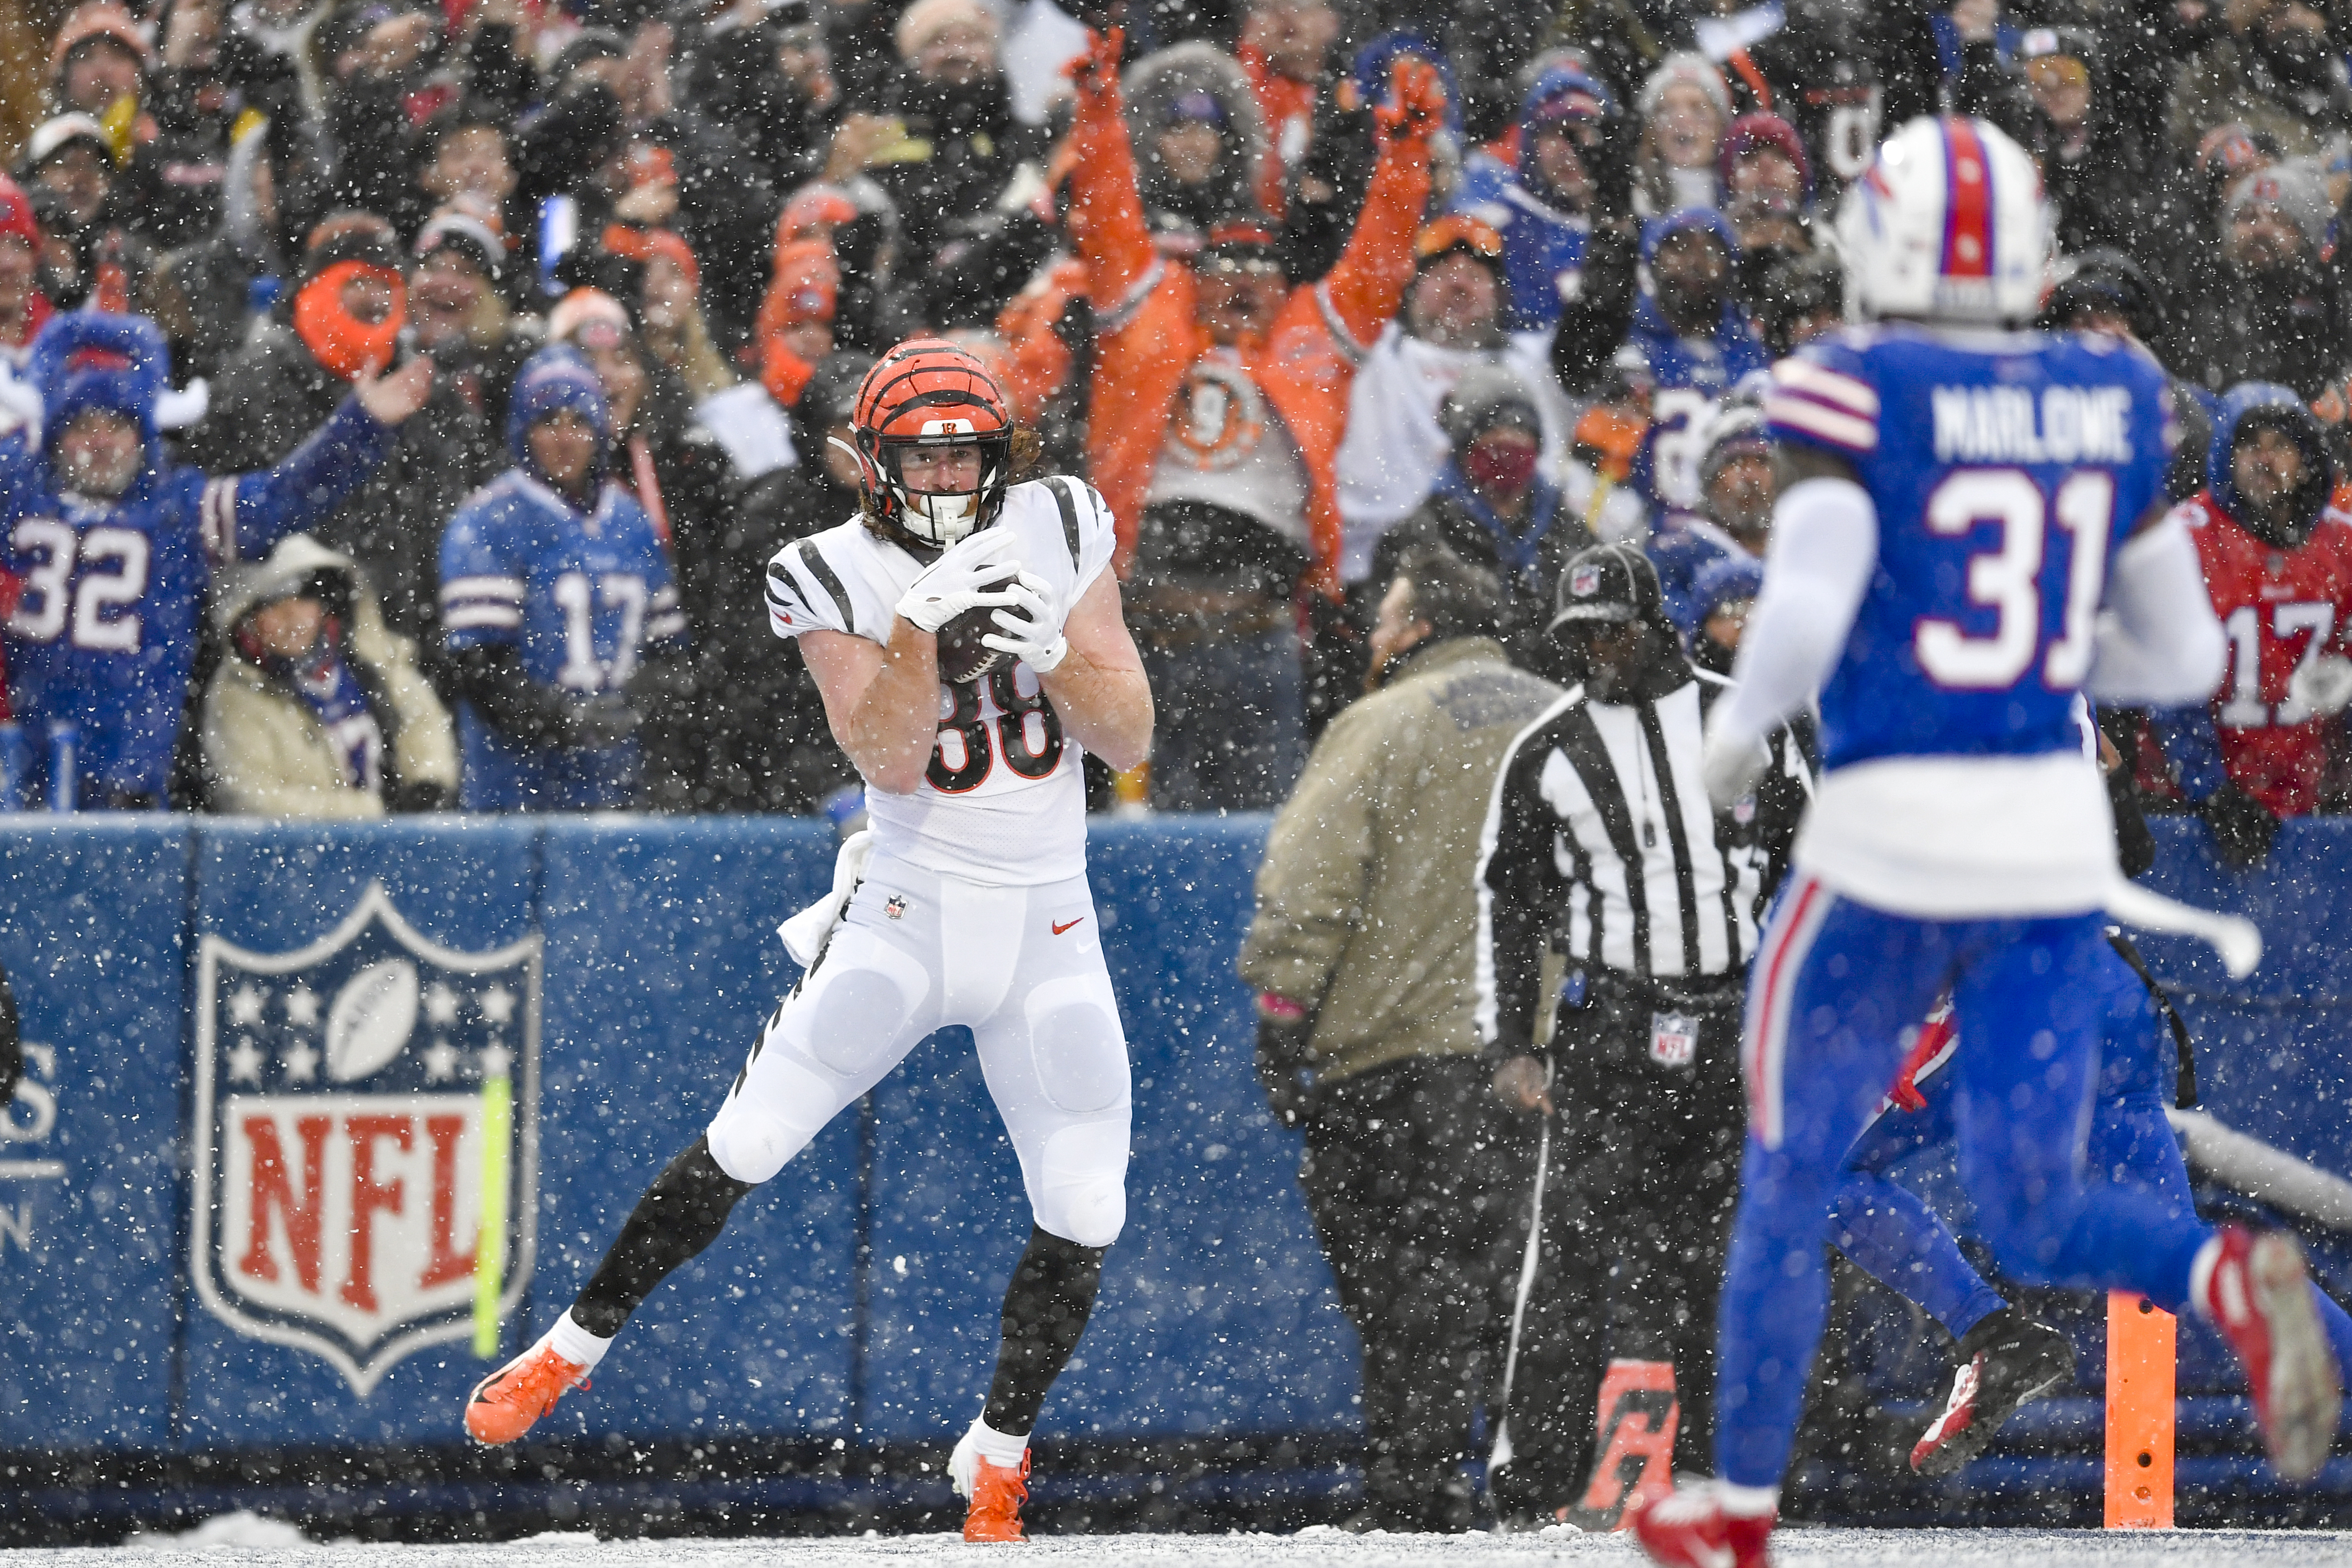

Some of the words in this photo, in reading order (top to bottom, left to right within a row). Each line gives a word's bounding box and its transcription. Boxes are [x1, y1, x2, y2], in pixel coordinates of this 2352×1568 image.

[1931, 385, 2133, 464] MARLOWE
[7, 516, 148, 649] 32
[554, 571, 645, 689] 17
[1914, 465, 2114, 691] 31
[2220, 601, 2334, 727] 17
[1657, 1034, 1688, 1058] NFL
[239, 1115, 487, 1313] NFL
